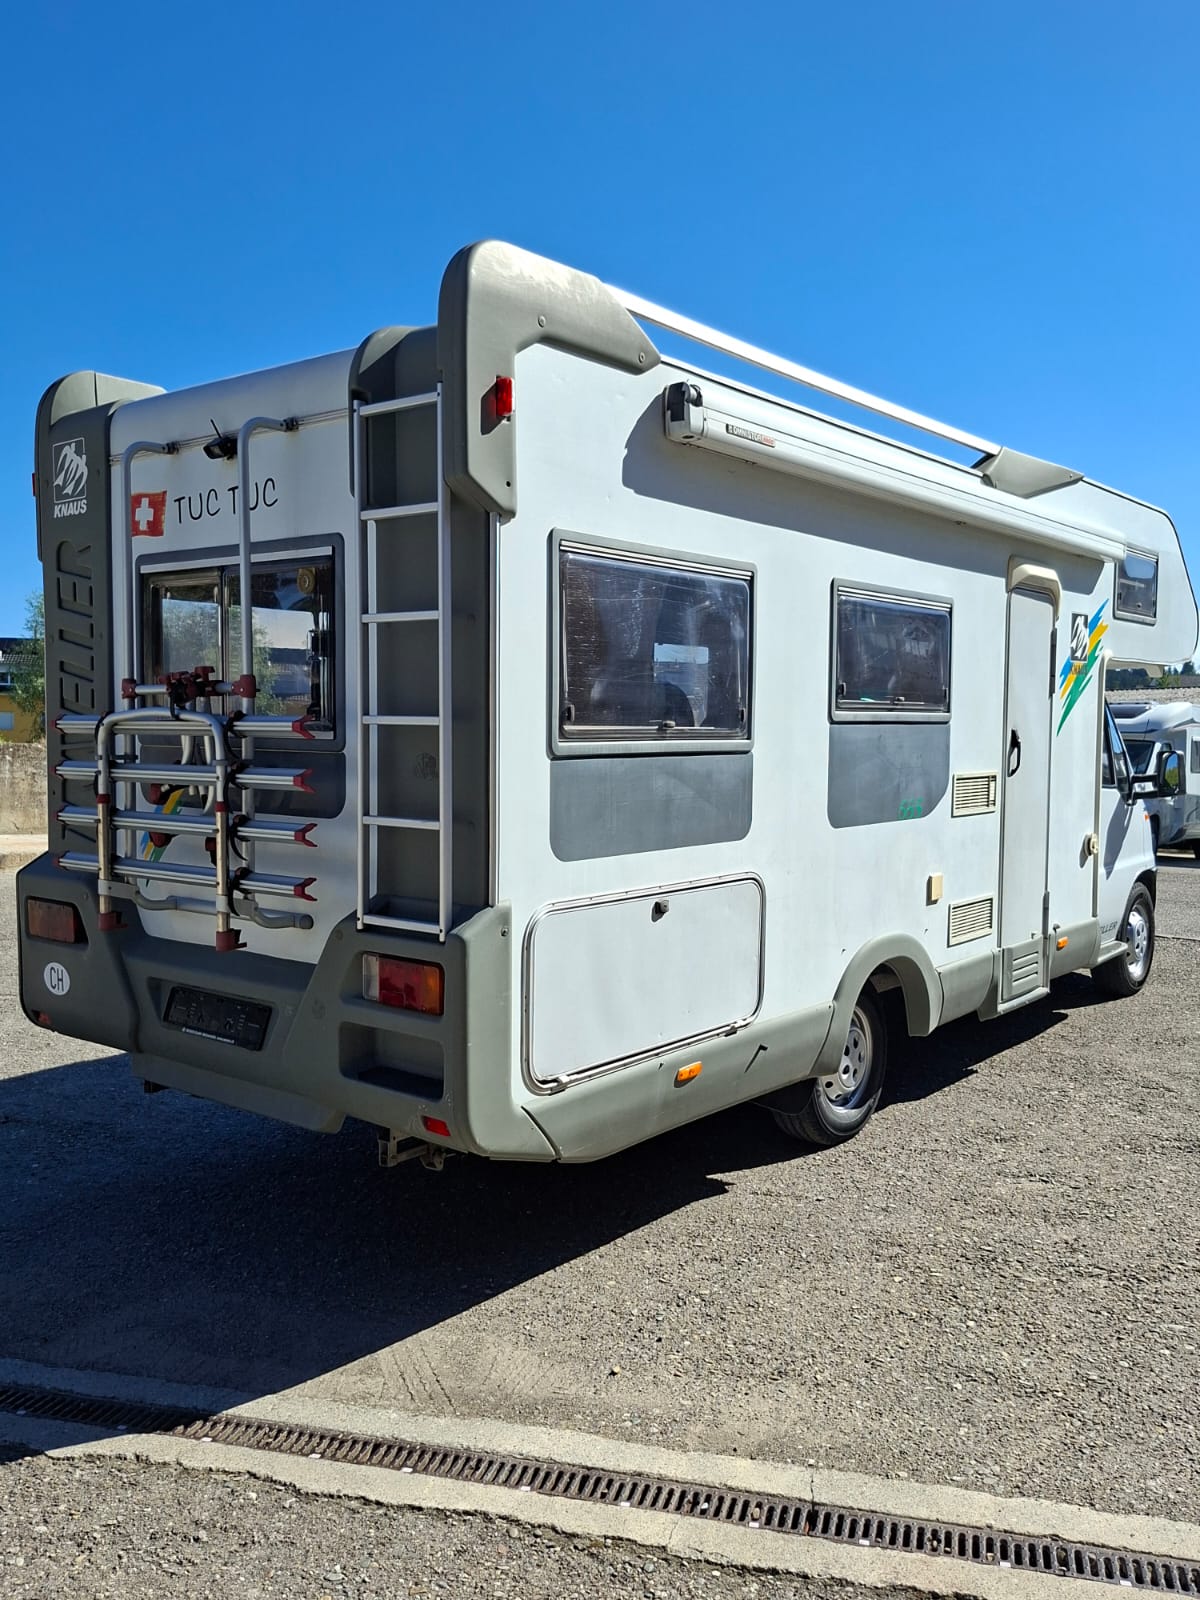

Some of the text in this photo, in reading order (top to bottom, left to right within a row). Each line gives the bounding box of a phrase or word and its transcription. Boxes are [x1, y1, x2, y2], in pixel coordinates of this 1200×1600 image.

[54, 500, 87, 518] KNAUS
[174, 489, 221, 524] TUC
[50, 966, 65, 992] CH
